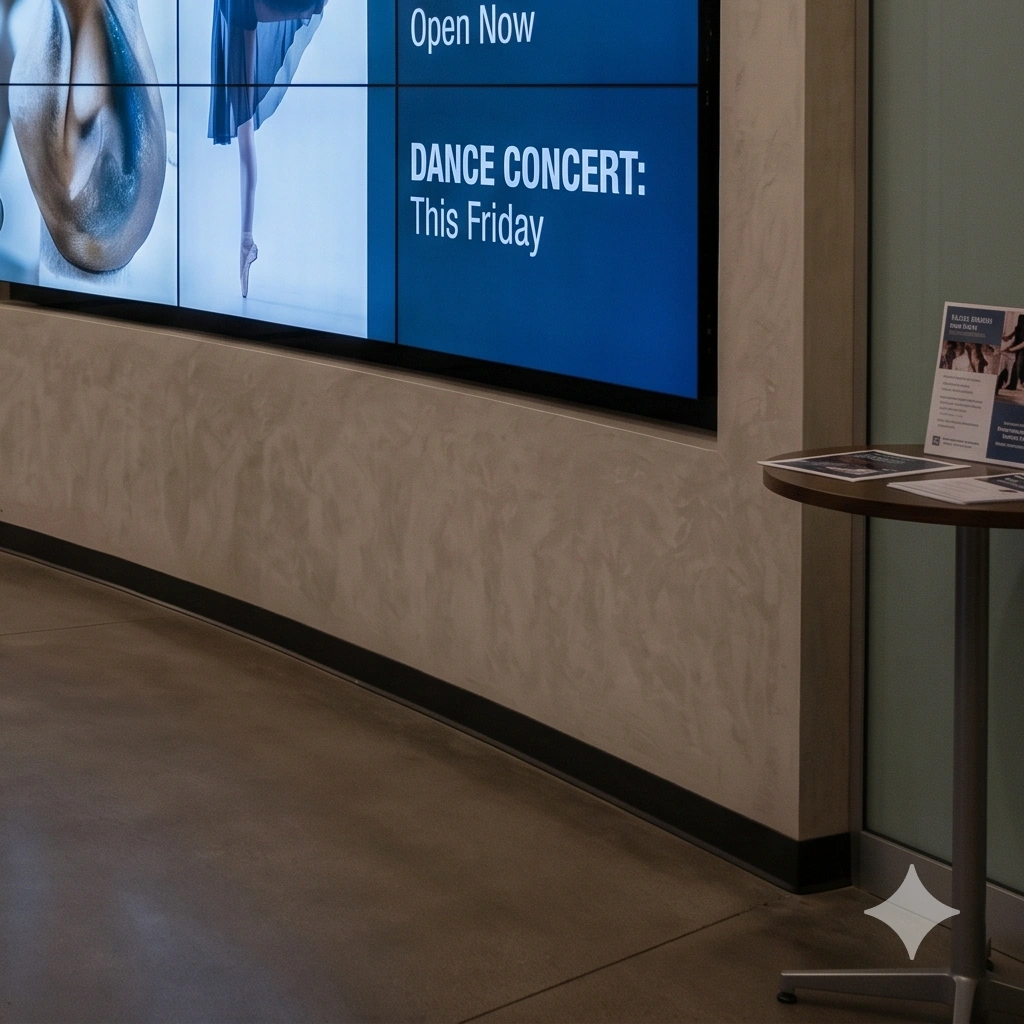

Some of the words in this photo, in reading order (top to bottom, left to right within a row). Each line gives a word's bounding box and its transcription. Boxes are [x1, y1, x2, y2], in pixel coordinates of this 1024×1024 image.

[410, 7, 471, 55] Open
[479, 4, 535, 44] Now
[411, 142, 495, 186] DANCE
[503, 145, 646, 196] CONCERT:
[410, 196, 458, 239] This
[467, 201, 544, 257] Friday
